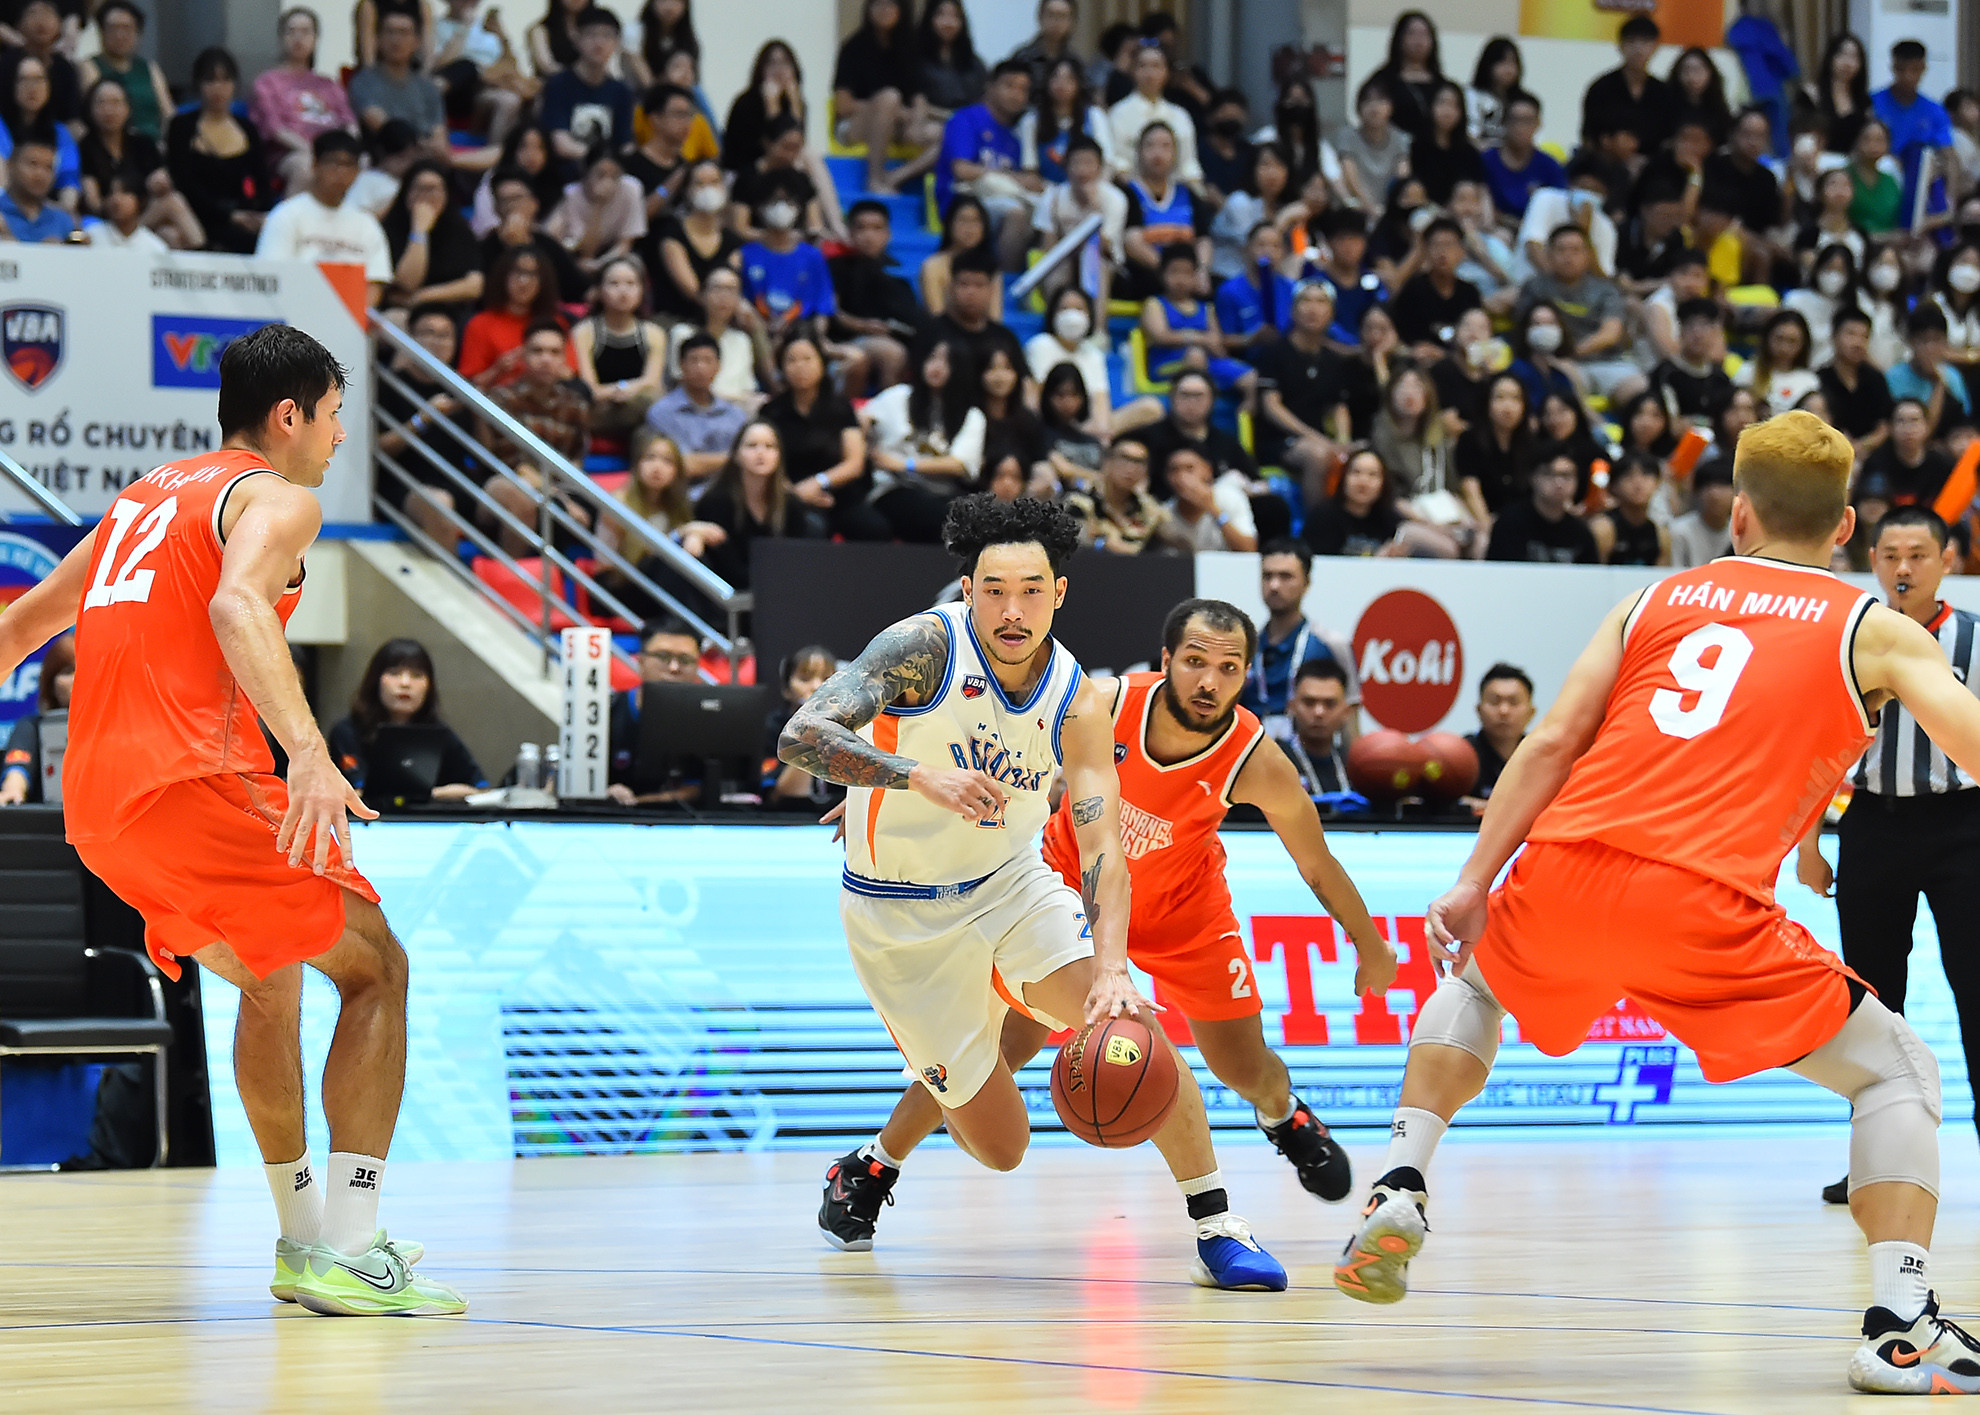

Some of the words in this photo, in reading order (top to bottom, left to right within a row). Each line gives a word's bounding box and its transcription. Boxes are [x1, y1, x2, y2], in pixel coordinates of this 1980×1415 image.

[6, 311, 58, 343] VBA
[103, 467, 146, 491] NA
[83, 496, 178, 613] 12
[588, 634, 602, 660] 5
[1359, 638, 1456, 686] Kohi
[586, 668, 599, 693] 4
[967, 677, 985, 689] VBA
[1648, 622, 1754, 740] 9
[587, 701, 600, 726] 3
[586, 734, 599, 761] 2
[1228, 957, 1251, 999] 2
[294, 1176, 313, 1192] HOOPS
[349, 1179, 376, 1191] HOOPS
